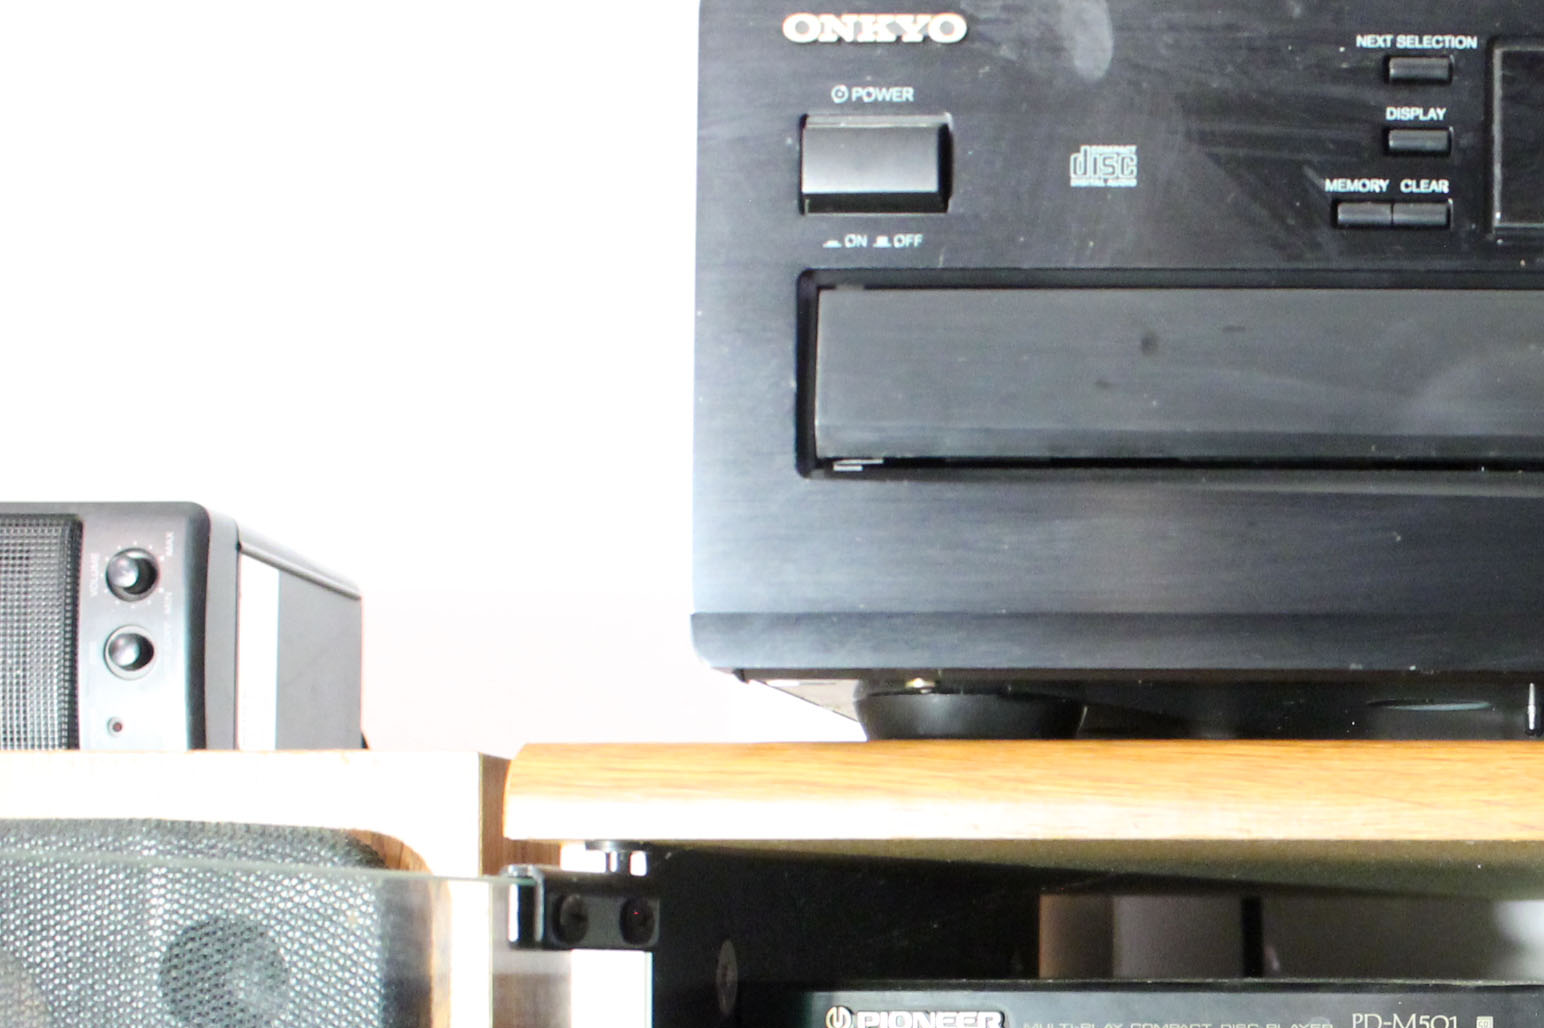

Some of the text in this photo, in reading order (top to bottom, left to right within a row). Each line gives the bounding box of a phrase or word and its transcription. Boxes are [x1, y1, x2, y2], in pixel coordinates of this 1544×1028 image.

[783, 13, 968, 44] ONKYO
[1356, 35, 1477, 49] NEXT SELECTION
[852, 87, 914, 101] POWER
[1386, 107, 1447, 121] DISPLAY
[1325, 179, 1389, 193] MEMORY
[1400, 180, 1449, 193] CLEAR
[845, 234, 867, 248] ON
[893, 234, 923, 248] OFF
